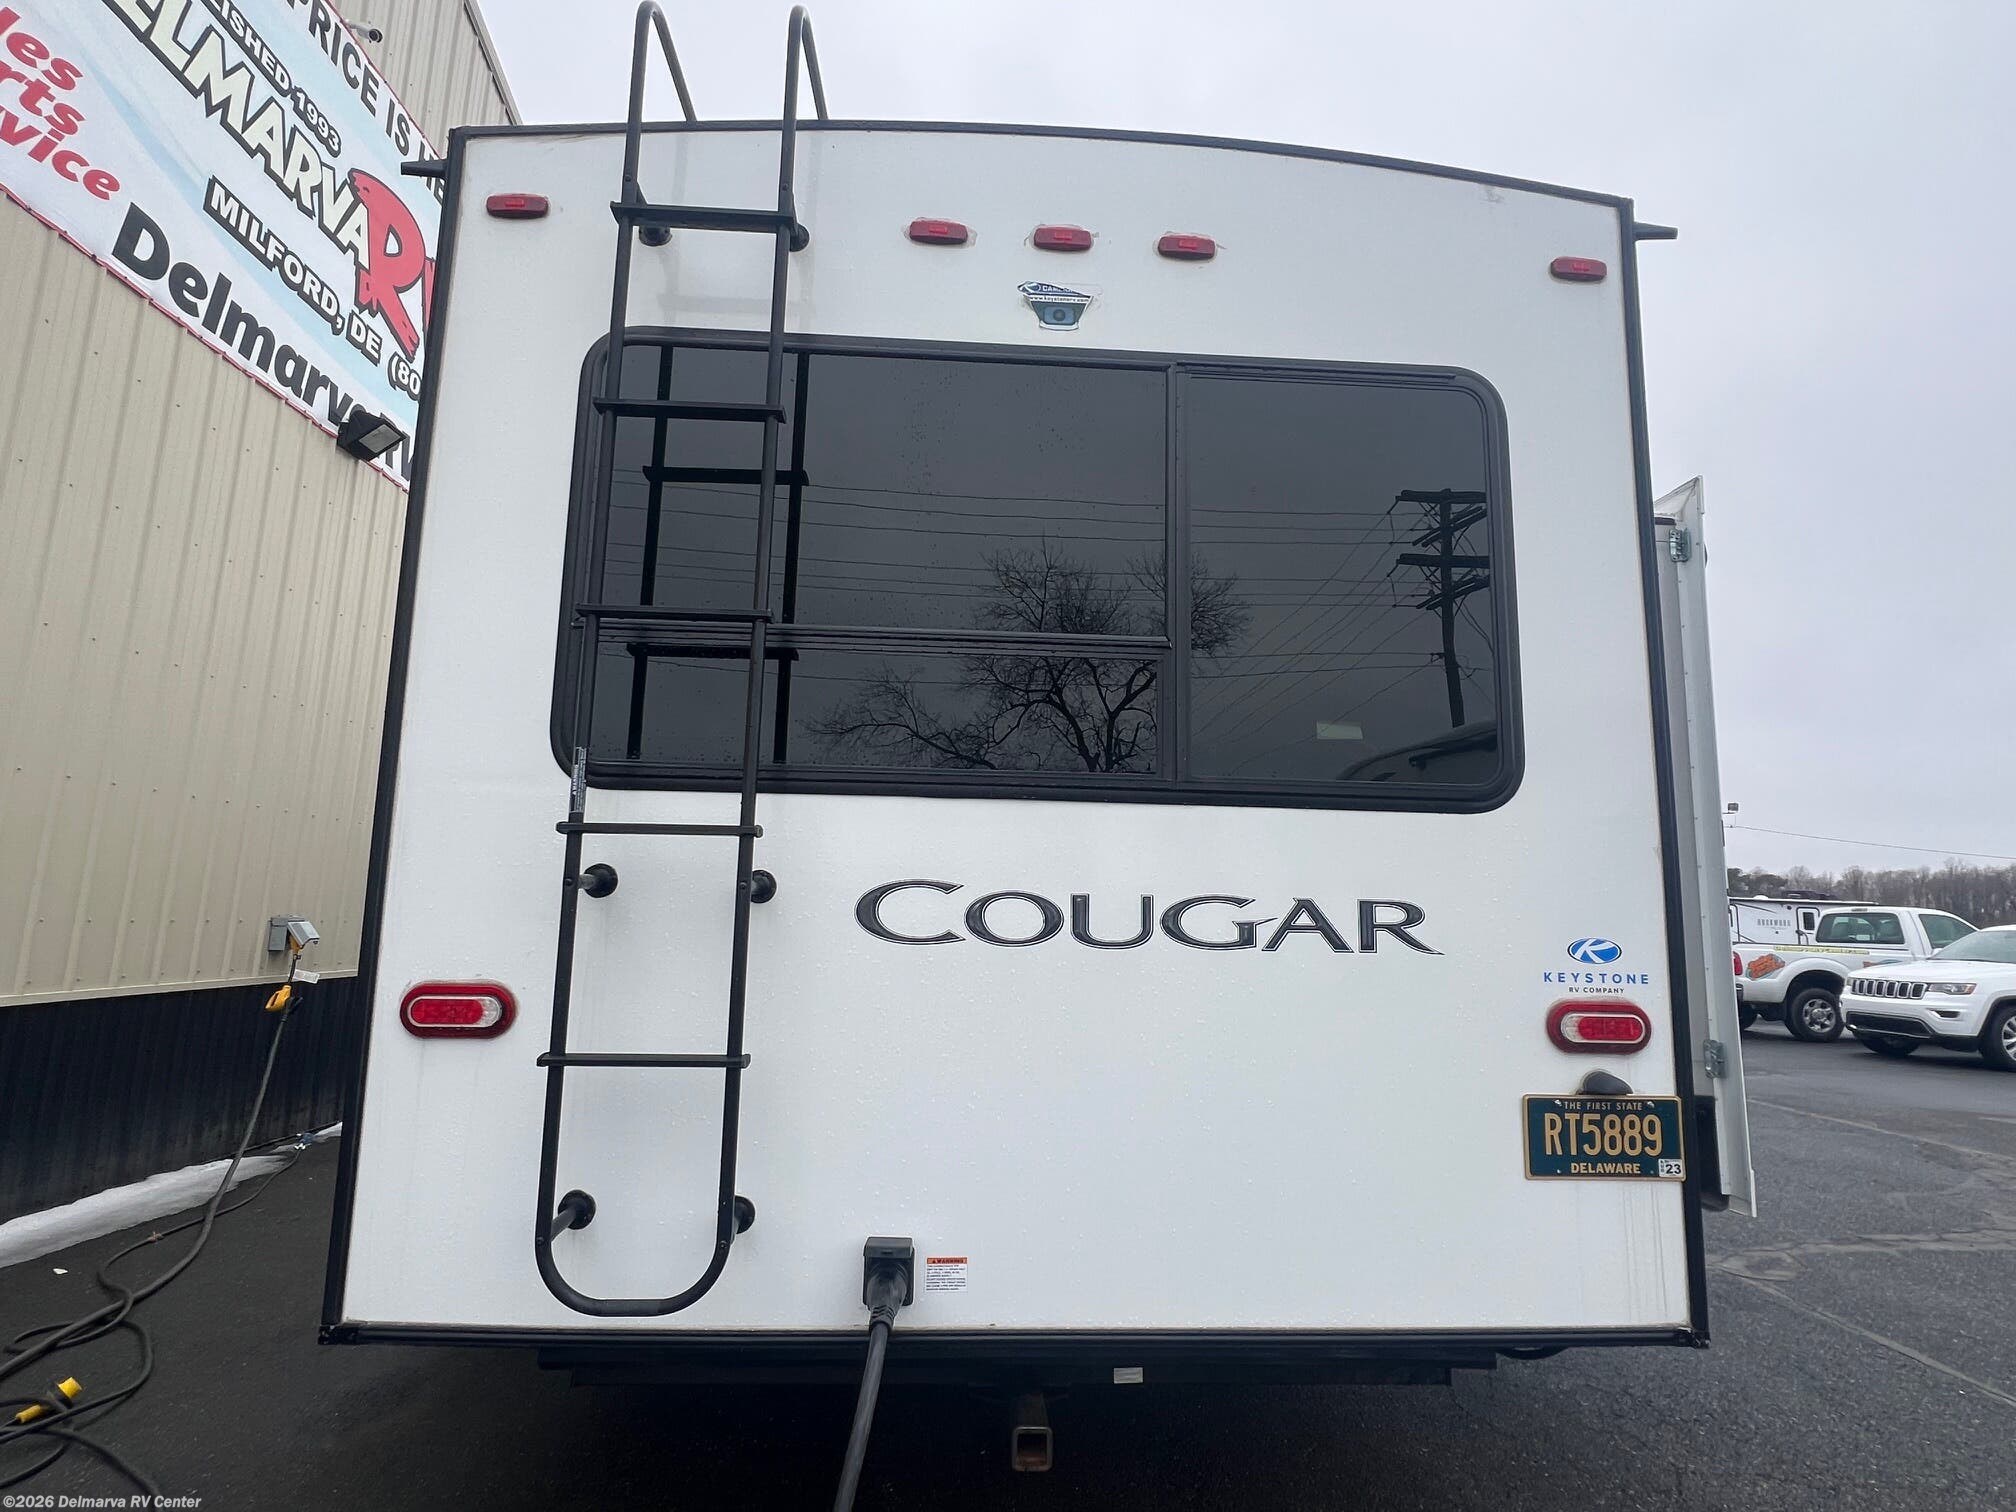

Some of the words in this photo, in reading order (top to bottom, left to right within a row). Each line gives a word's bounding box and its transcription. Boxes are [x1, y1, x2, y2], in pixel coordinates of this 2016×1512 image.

[206, 0, 291, 93] ISHED
[292, 88, 341, 154] 1993
[286, 0, 381, 118] RICE
[385, 97, 411, 156] IS
[205, 177, 343, 333] MILFORD,
[347, 312, 382, 365] DE
[111, 202, 369, 427] Delmarv
[853, 878, 1444, 955] COUGAR
[1543, 972, 1649, 985] KEYSTONE
[1583, 986, 1625, 994] COMPANY
[1544, 1113, 1663, 1157] RT5889
[1564, 1101, 1581, 1110] THE
[1586, 1101, 1611, 1110] FIRST
[1616, 1101, 1643, 1111] STATE
[1570, 1162, 1641, 1174] DELAWARE
[1665, 1163, 1682, 1175] 23
